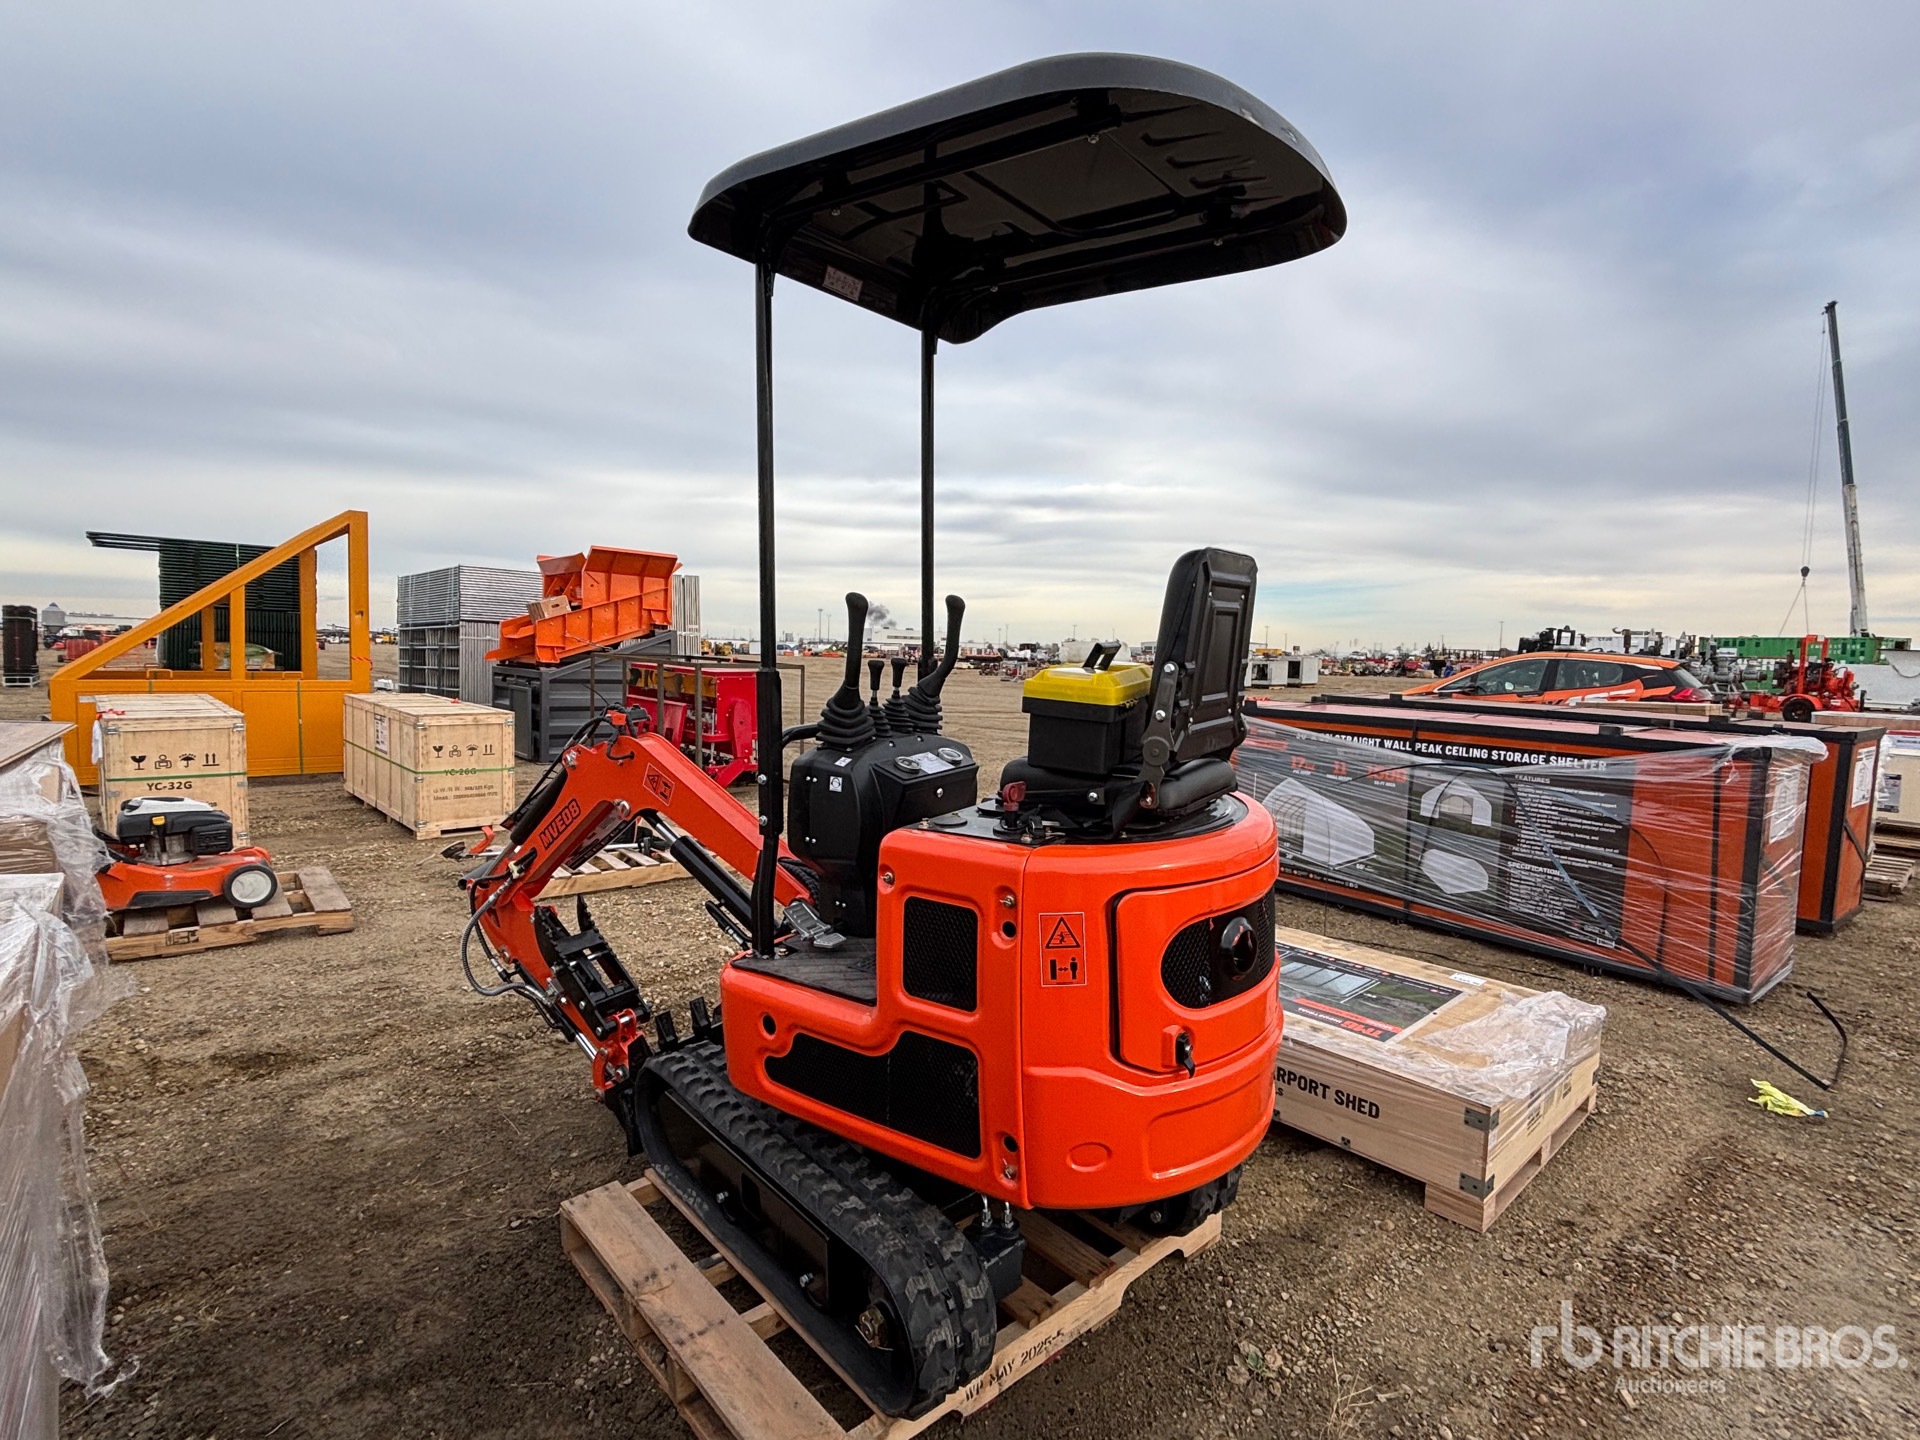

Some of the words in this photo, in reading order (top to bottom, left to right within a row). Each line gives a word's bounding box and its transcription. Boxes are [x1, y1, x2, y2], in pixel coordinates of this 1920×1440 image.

[1384, 739, 1412, 751] WALL
[1415, 743, 1442, 754] PEAK
[1445, 745, 1488, 759] CEILING
[1492, 751, 1546, 765] STORAGE
[1549, 755, 1607, 771] SHELTER
[146, 781, 193, 791] YC-32G
[1514, 774, 1551, 784] FEATURES
[539, 798, 582, 850] MVE08
[1340, 1020, 1382, 1038] TMG
[1273, 1066, 1330, 1100] RPORT
[1334, 1089, 1380, 1119] SHED
